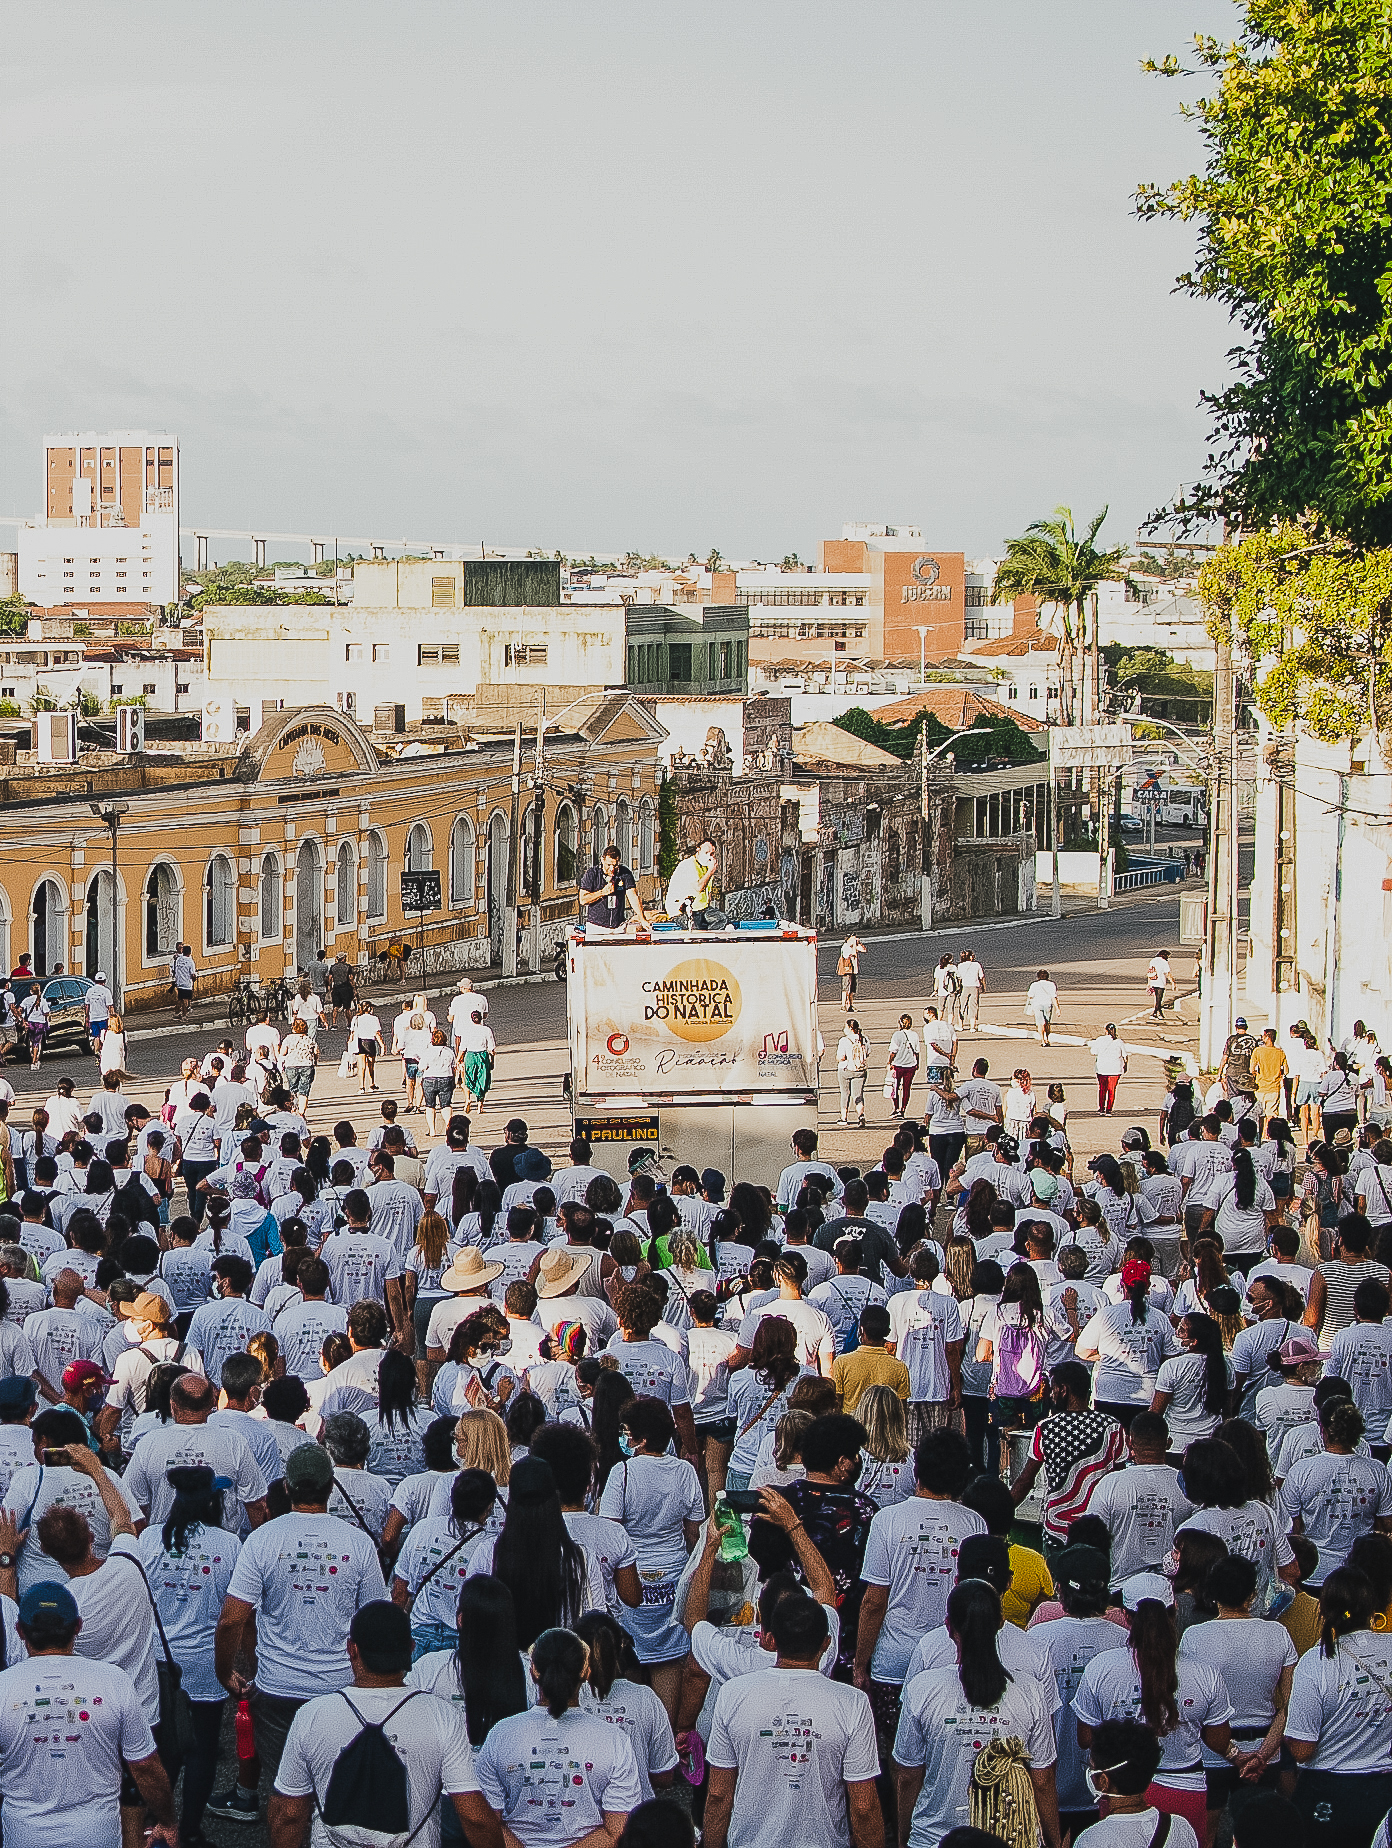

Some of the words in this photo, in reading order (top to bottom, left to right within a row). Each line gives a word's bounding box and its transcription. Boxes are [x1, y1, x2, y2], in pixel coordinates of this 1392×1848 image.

[641, 979, 730, 993] CAMINHADA
[644, 1005, 670, 1020] DO
[673, 1003, 734, 1020] NATAL
[590, 1128, 659, 1141] PAULINO
